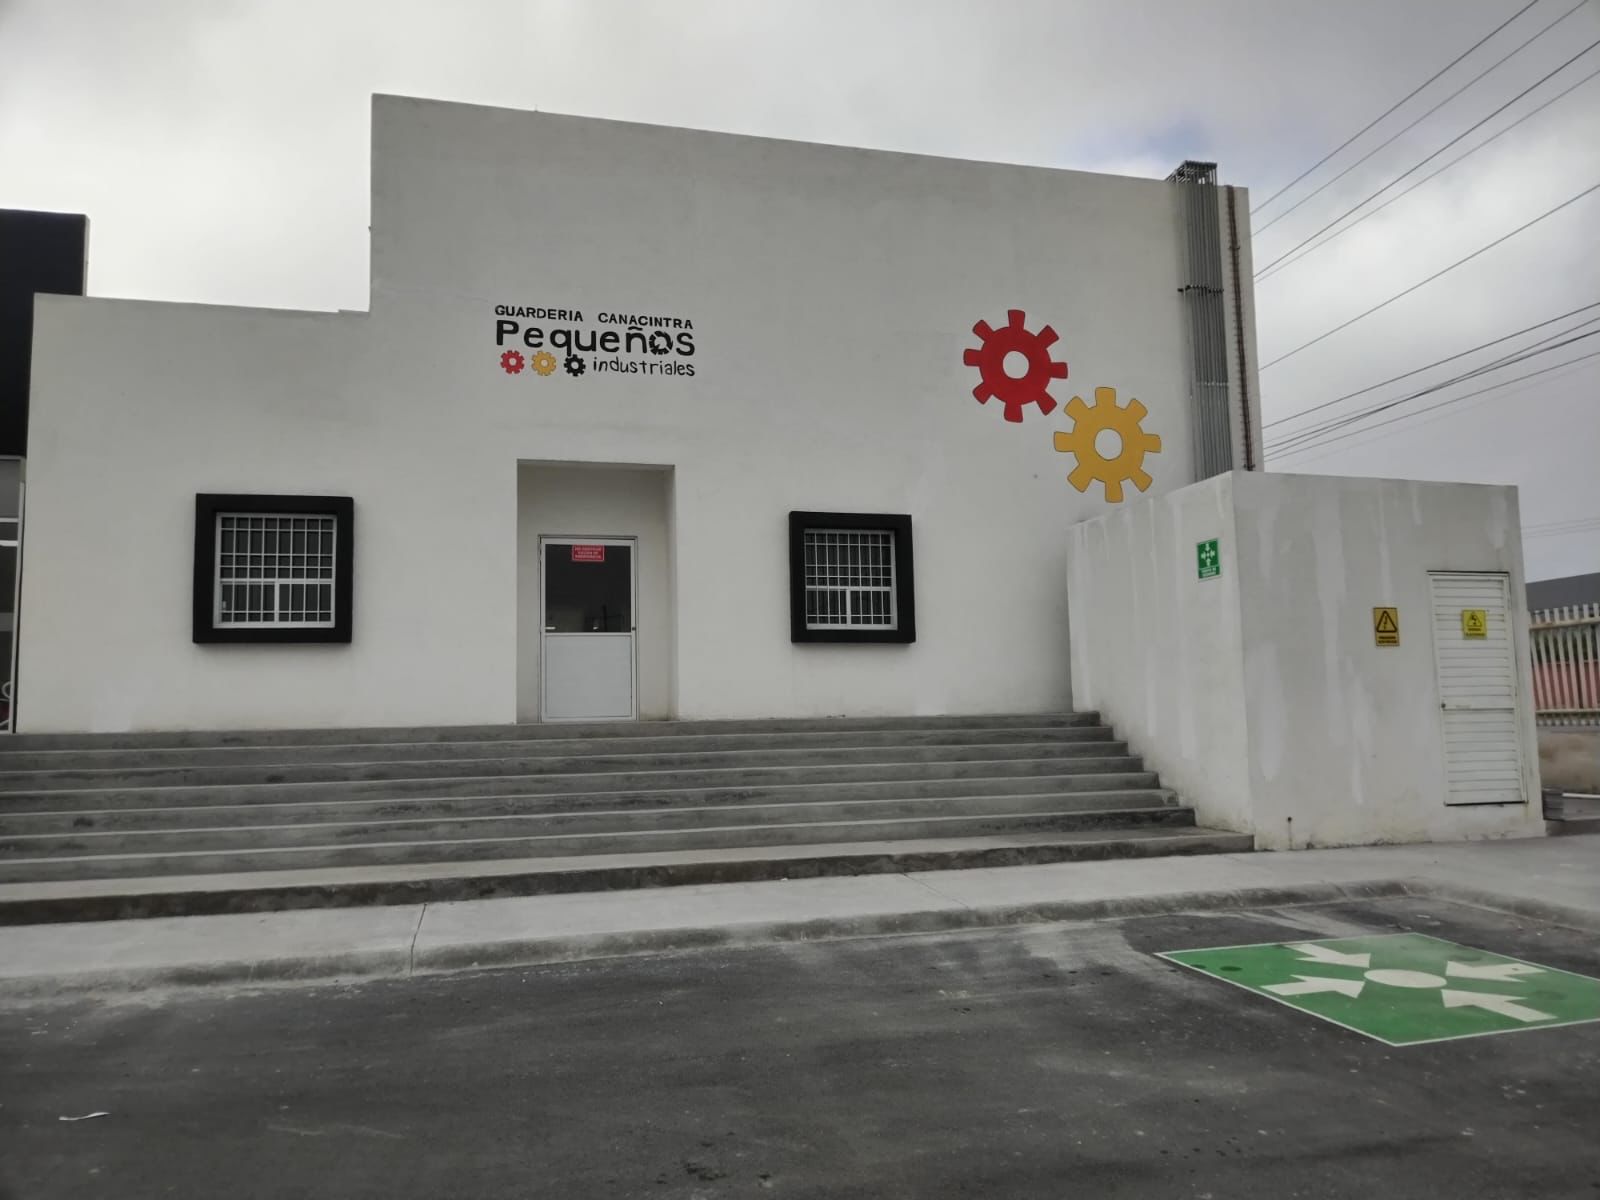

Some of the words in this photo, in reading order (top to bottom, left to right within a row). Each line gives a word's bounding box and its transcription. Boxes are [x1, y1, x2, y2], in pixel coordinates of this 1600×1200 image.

[495, 304, 583, 322] GUARDERIA
[598, 312, 694, 330] CANACINTRA
[496, 319, 695, 357] Pequeños
[593, 356, 695, 377] industriales
